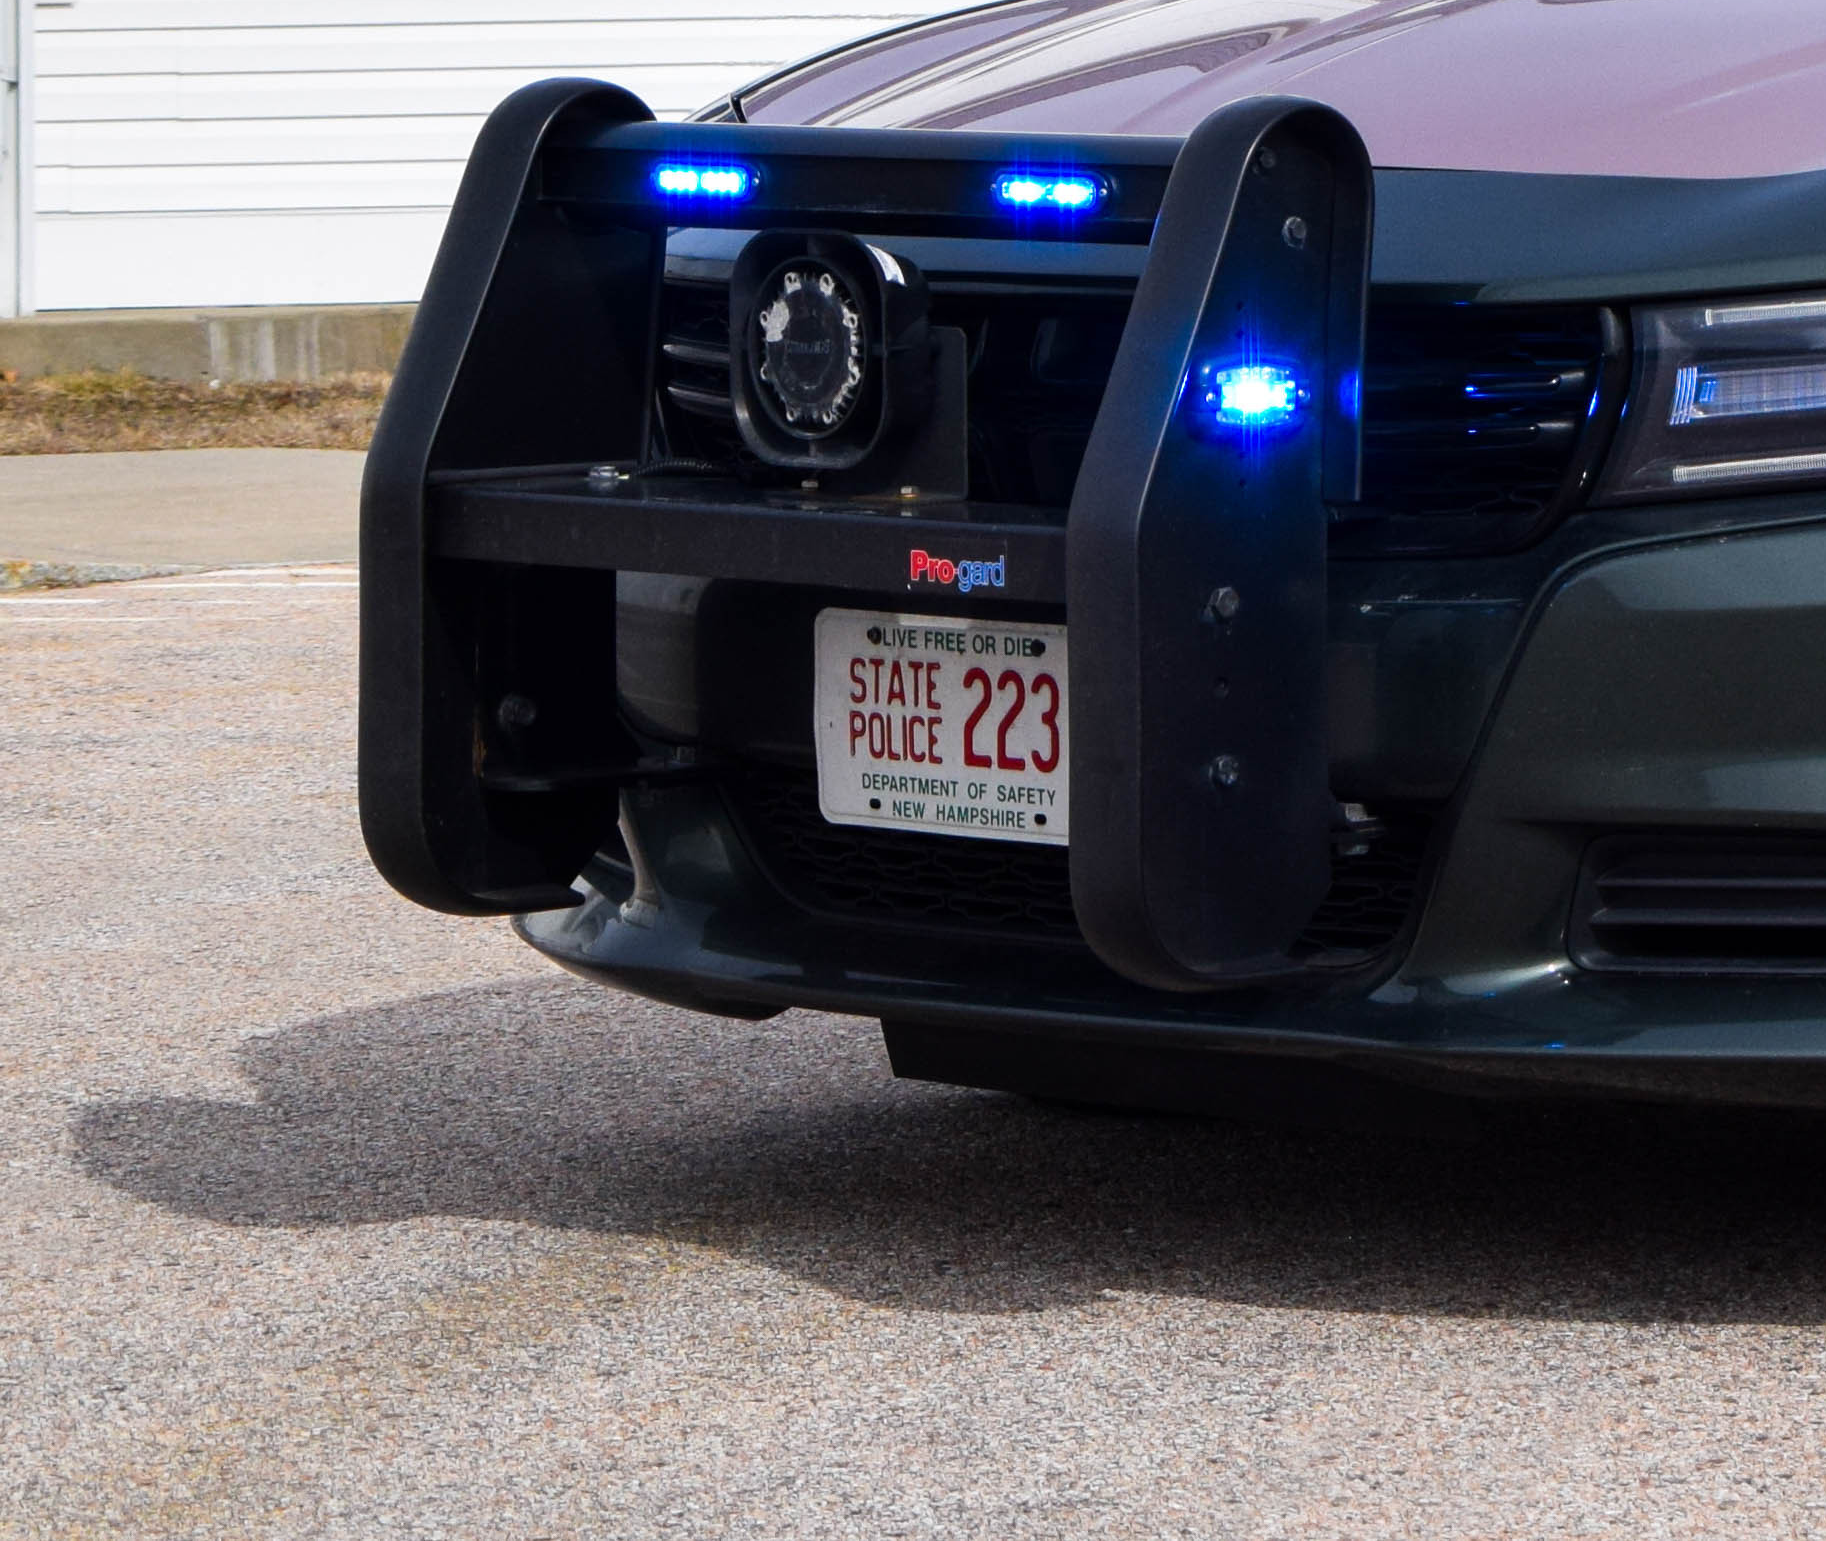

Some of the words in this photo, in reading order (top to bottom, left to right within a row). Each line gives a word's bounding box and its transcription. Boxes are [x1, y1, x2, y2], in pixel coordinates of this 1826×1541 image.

[882, 629, 918, 649] LIVE
[924, 631, 966, 653] FREE
[972, 634, 996, 655] OR
[1004, 637, 1033, 658] DIE
[850, 658, 942, 710] STATE
[849, 710, 943, 764] POLICE
[963, 667, 1060, 773] 223
[862, 773, 958, 798] DEPARTMENT
[967, 783, 987, 800] OF
[997, 785, 1056, 806] SAFETY
[892, 800, 925, 819] NEW
[936, 804, 1026, 828] HAMPSHIRE
